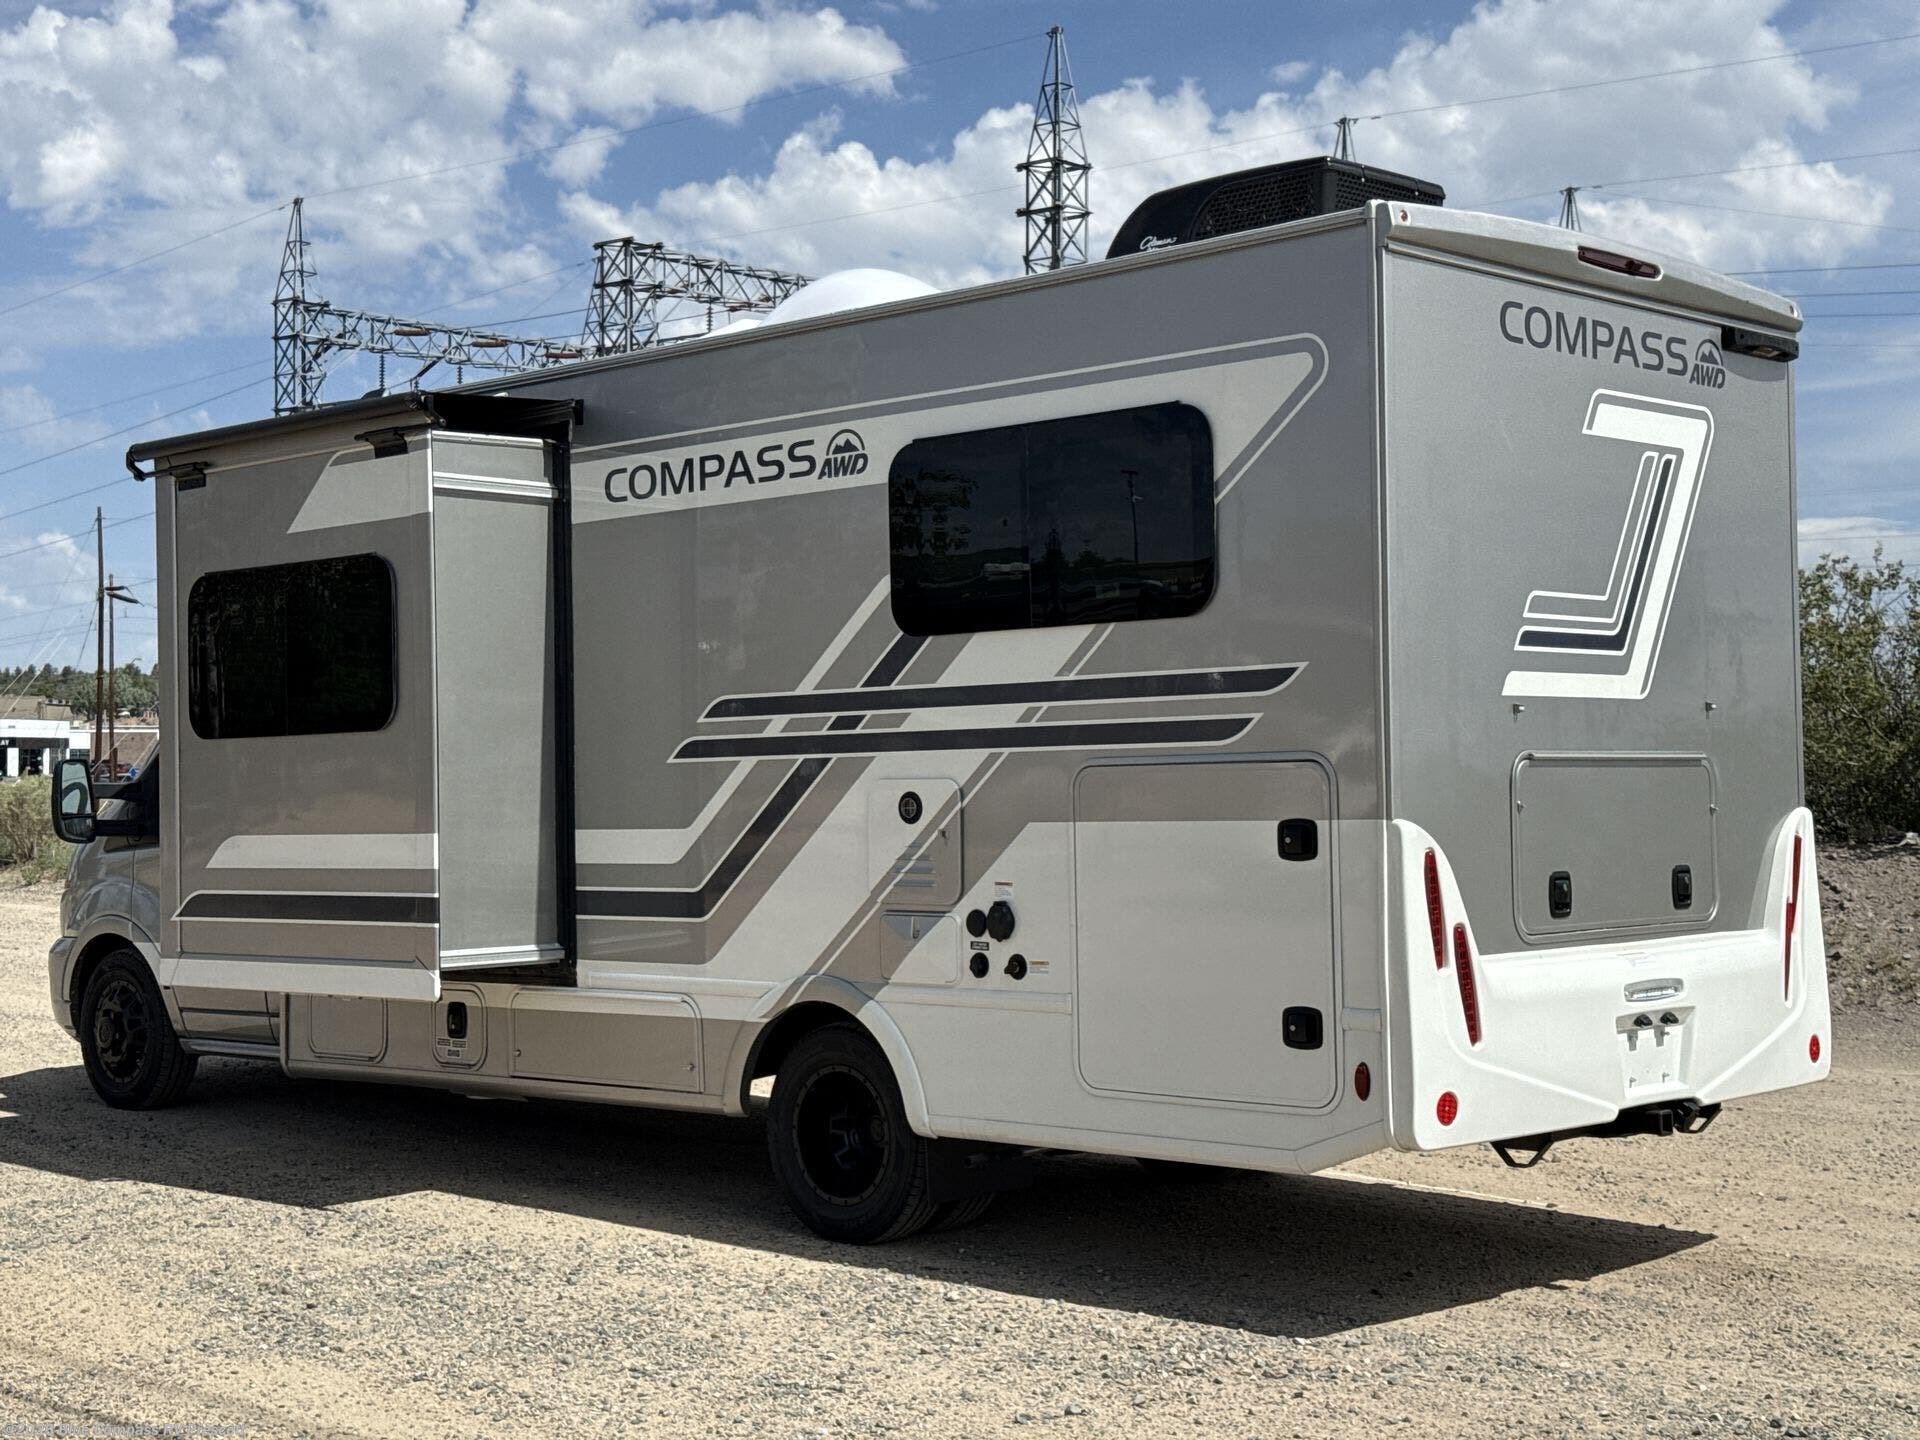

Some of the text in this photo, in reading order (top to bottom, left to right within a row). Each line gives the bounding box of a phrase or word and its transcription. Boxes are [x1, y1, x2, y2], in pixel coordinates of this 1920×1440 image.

[1499, 300, 1726, 389] COMPASS AWD
[604, 439, 868, 503] COMPASS AWD
